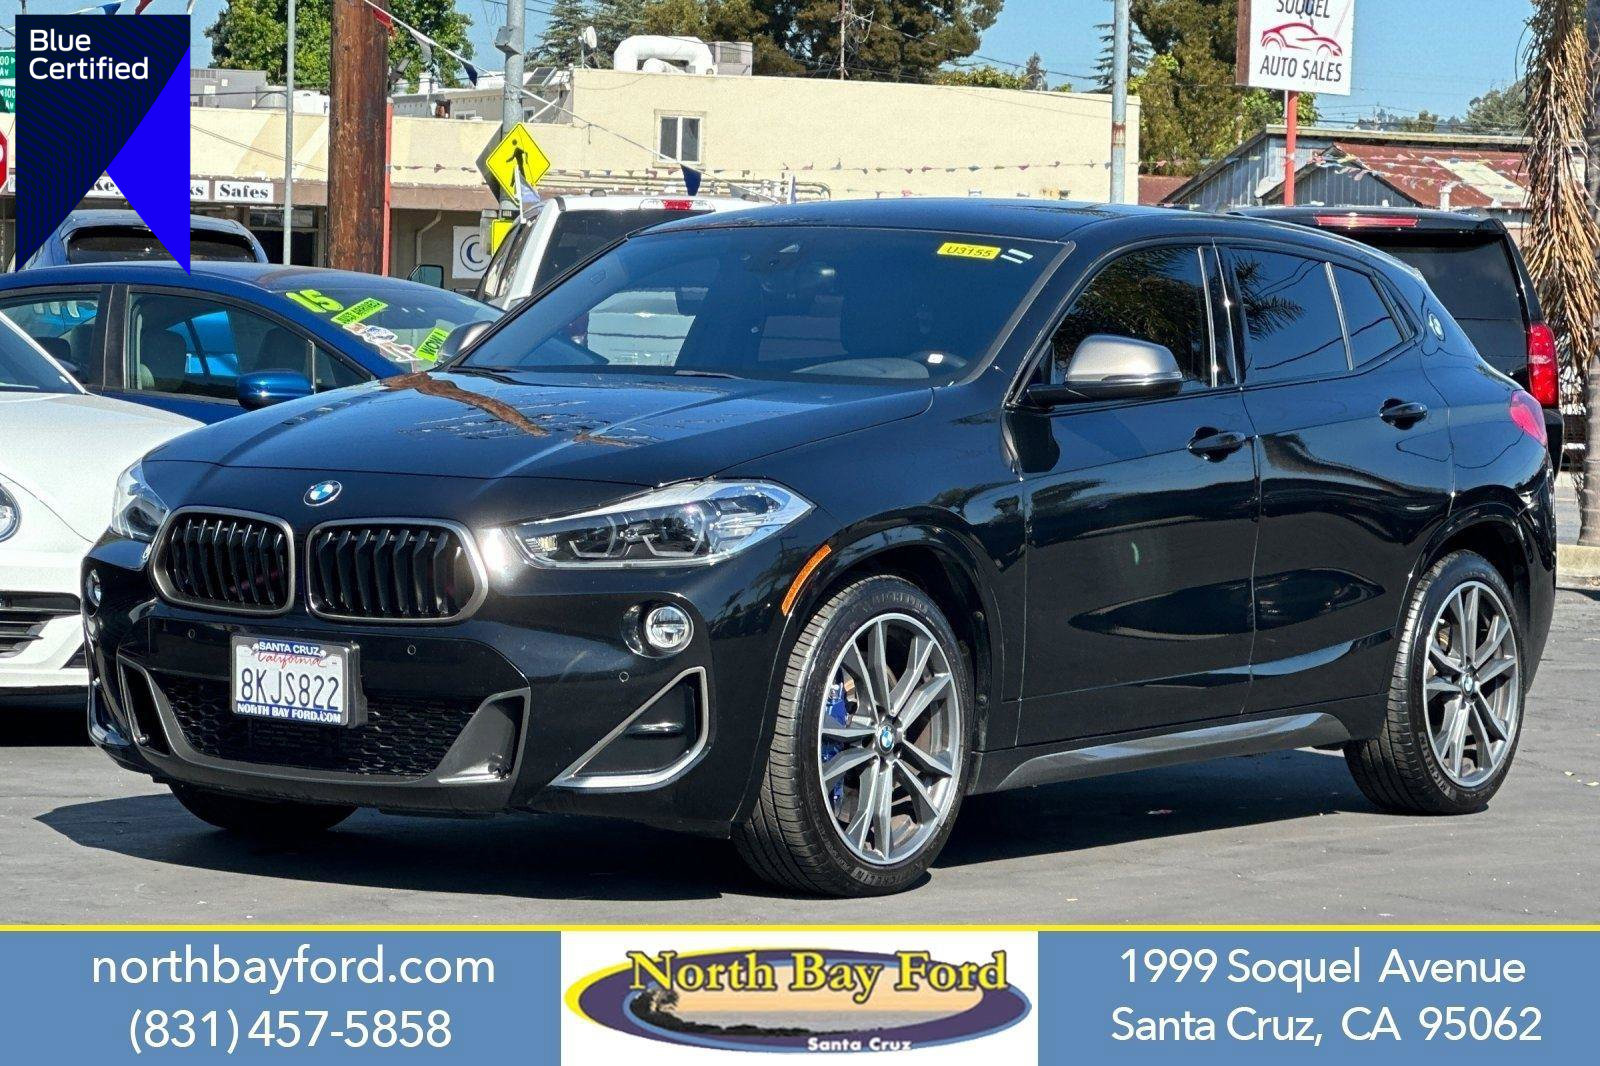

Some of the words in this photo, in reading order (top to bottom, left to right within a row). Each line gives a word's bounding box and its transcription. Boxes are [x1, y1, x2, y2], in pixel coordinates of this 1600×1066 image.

[1276, 0, 1330, 19] SOQUEL
[1260, 55, 1298, 77] AUTO
[1301, 60, 1342, 82] SALES
[219, 182, 269, 199] Safes
[259, 641, 291, 652] SANTA
[292, 645, 320, 656] CRUZ
[241, 667, 339, 710] 8KJS822
[237, 702, 269, 716] NORTH
[271, 706, 290, 718] BAY
[291, 710, 341, 724] FORD.COM
